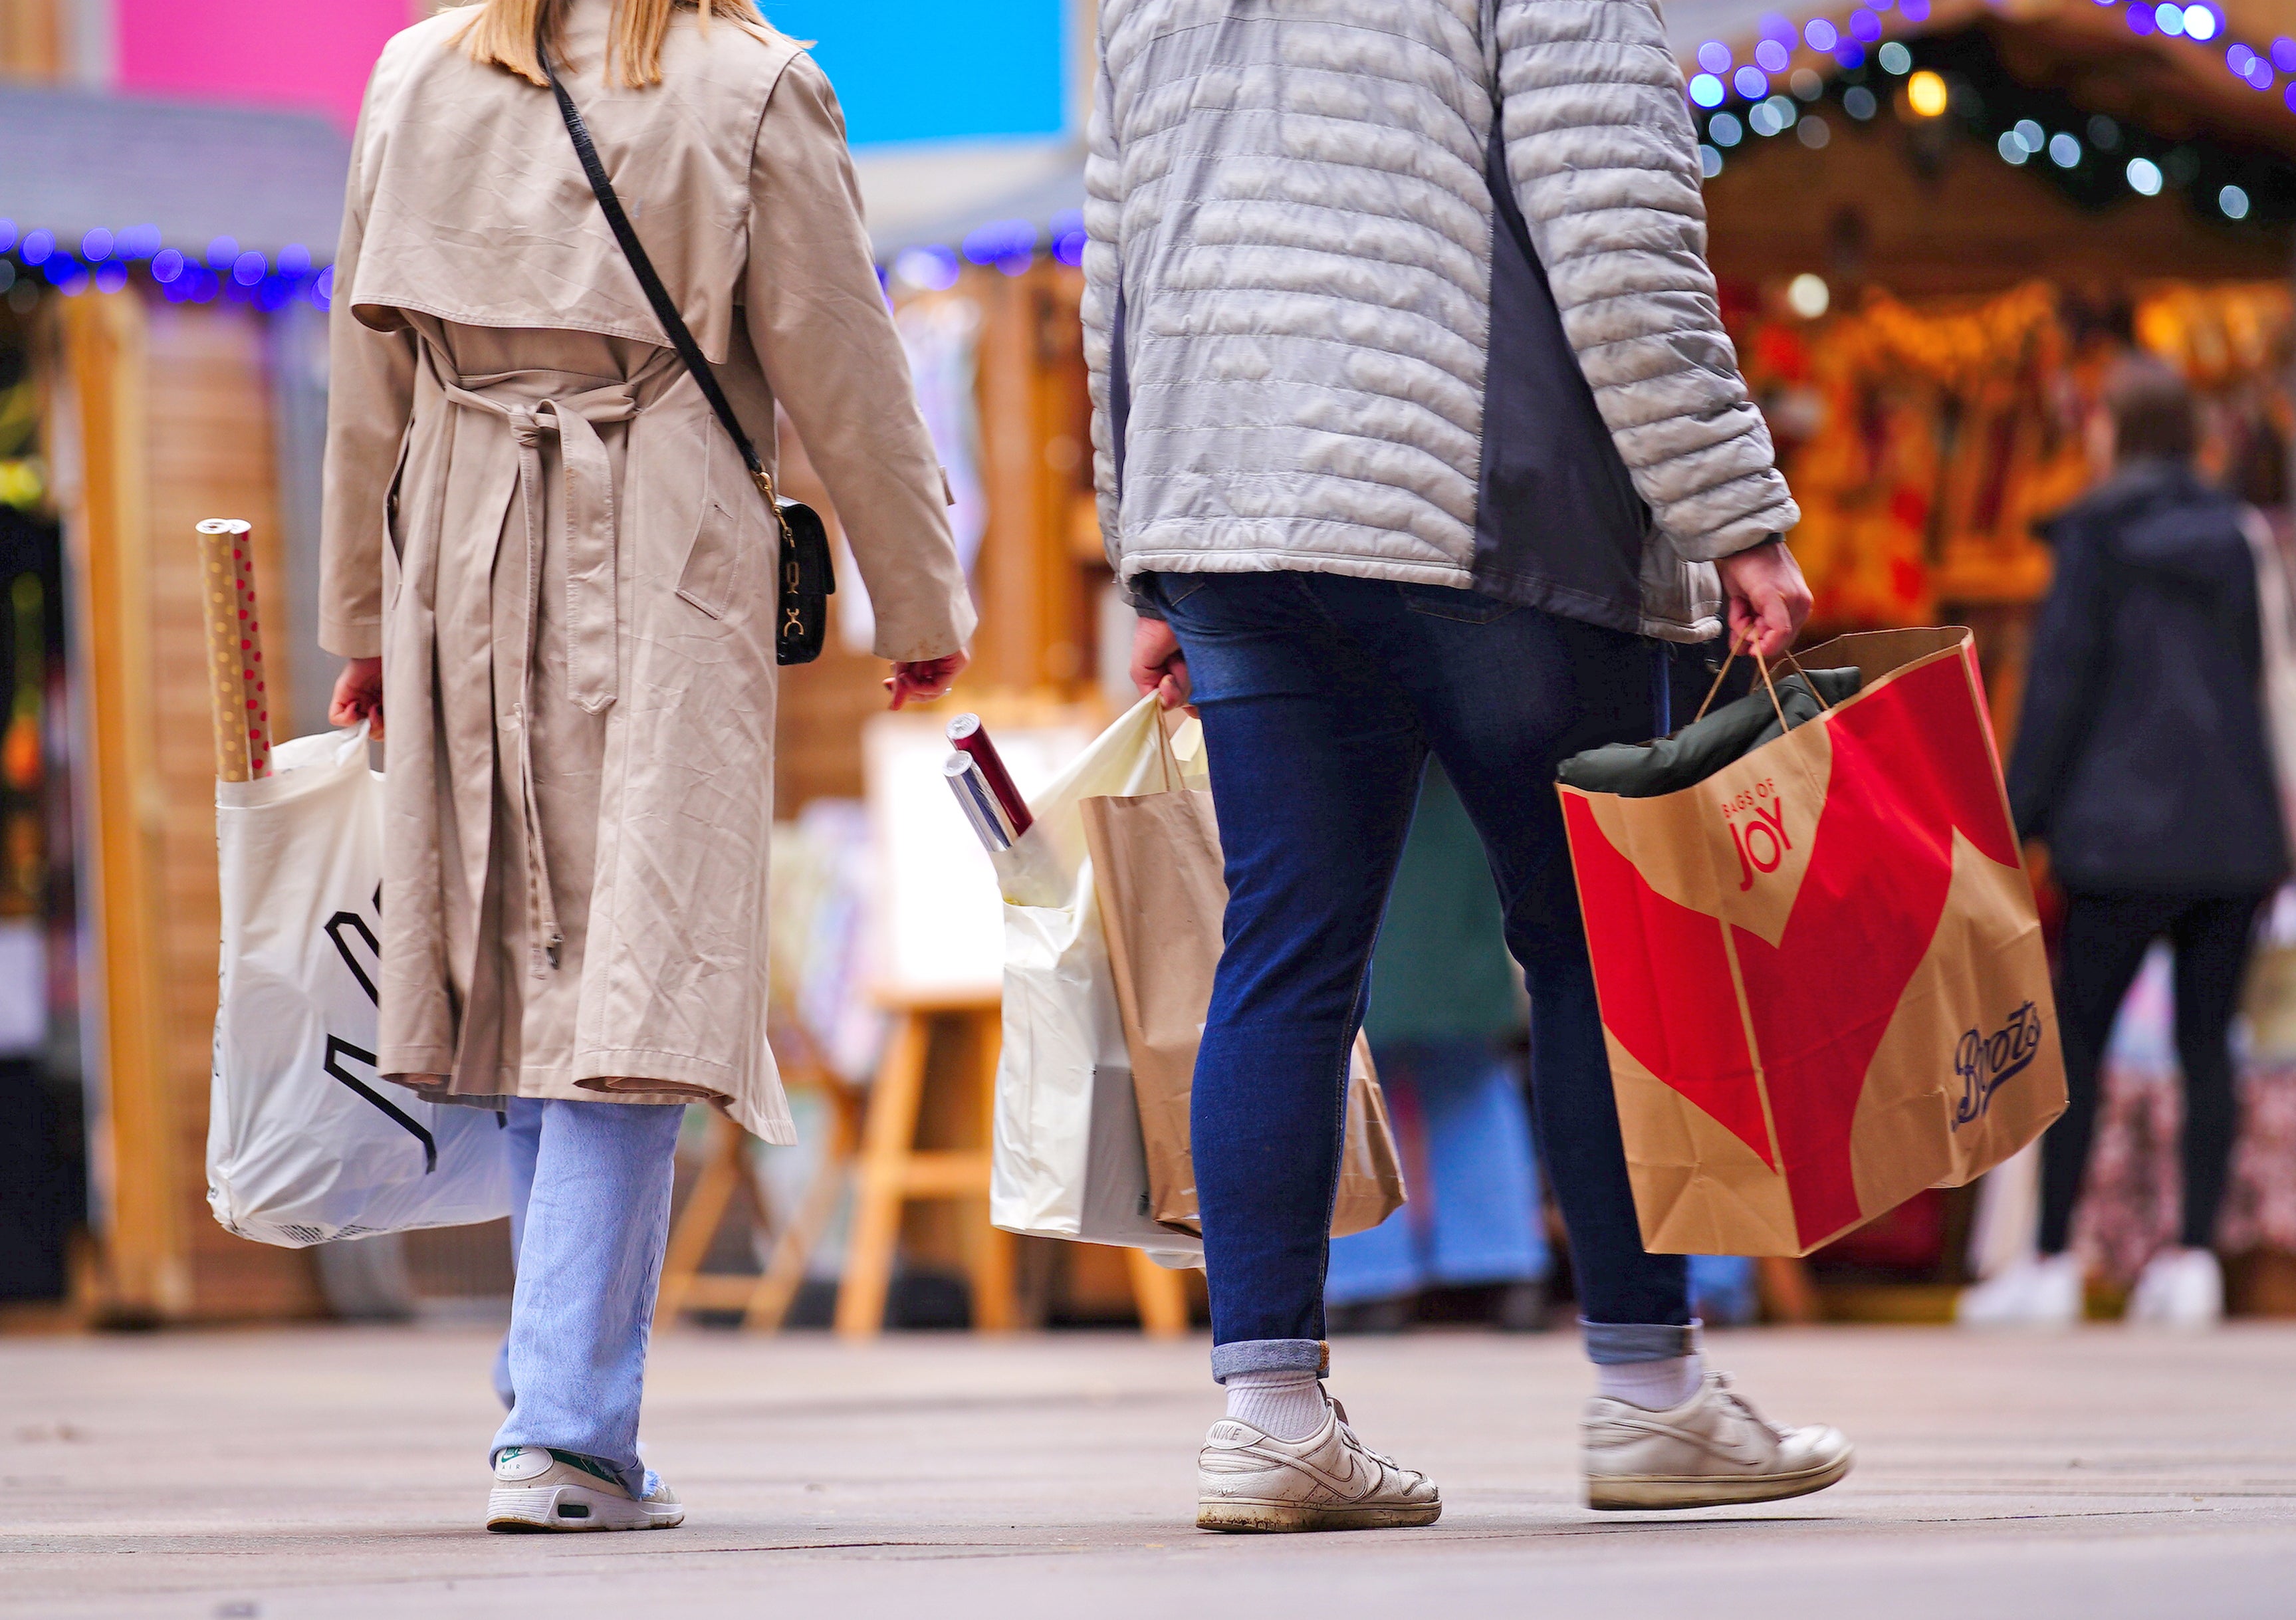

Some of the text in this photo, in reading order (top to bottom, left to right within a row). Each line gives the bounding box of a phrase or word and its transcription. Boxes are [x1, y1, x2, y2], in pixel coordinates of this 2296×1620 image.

[1722, 778, 1775, 818] BAGS OF
[1728, 796, 1792, 891] JOY
[1950, 1000, 2041, 1132] Boots
[1210, 1423, 1242, 1441] NIKE
